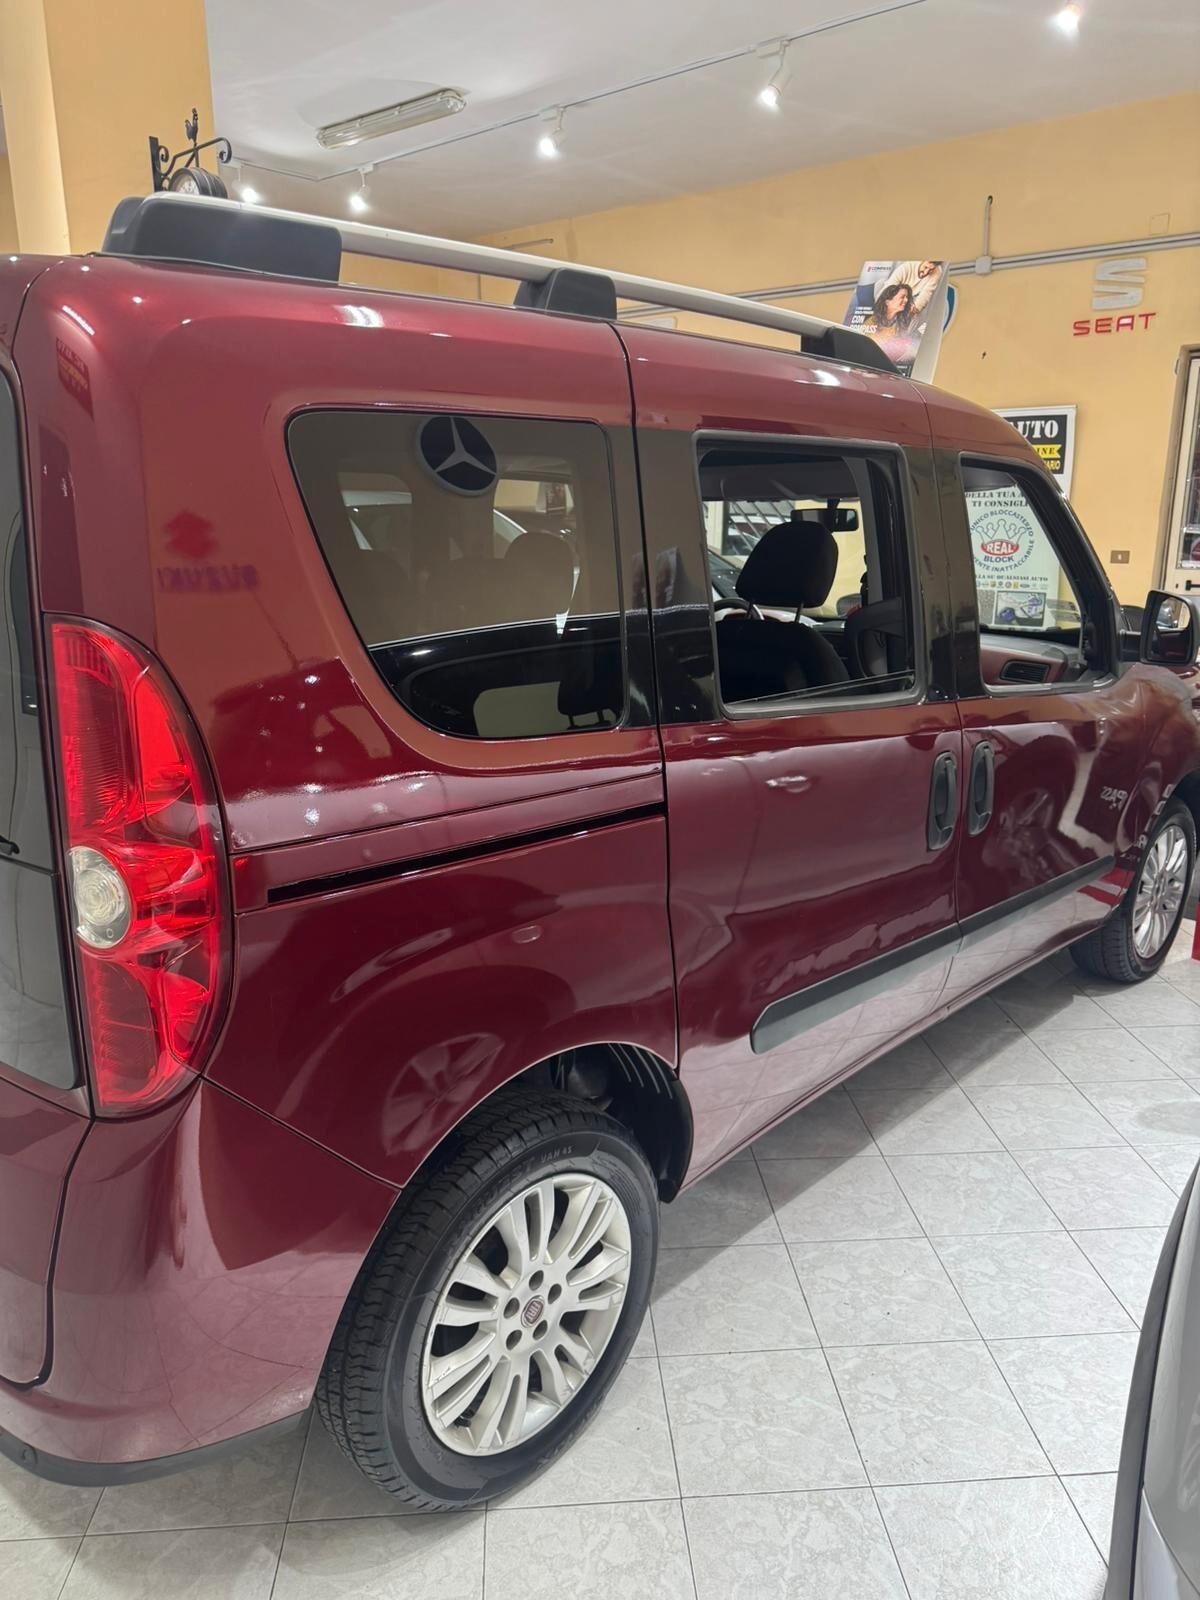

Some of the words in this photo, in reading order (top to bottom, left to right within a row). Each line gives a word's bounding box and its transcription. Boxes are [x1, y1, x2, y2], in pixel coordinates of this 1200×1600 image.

[851, 315, 866, 323] CON
[1073, 312, 1156, 336] SEAT
[986, 541, 1015, 553] REAL
